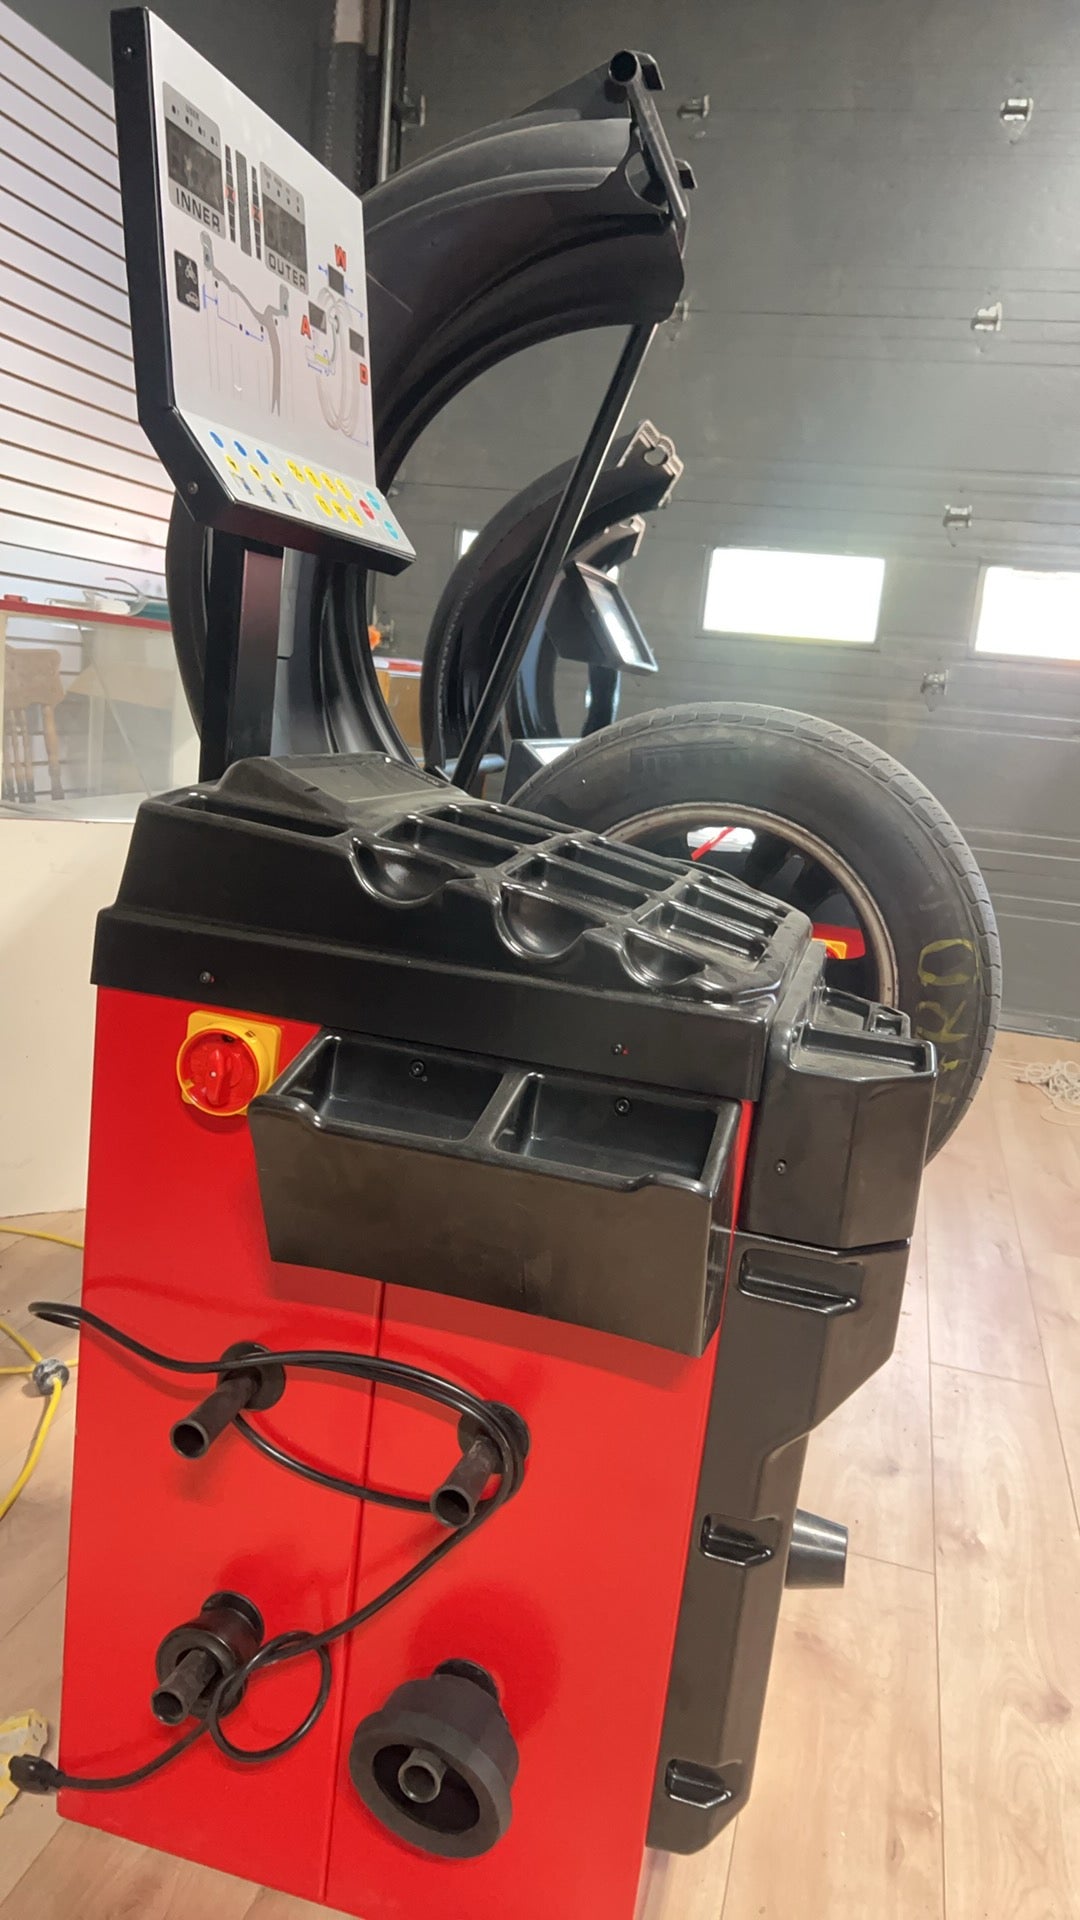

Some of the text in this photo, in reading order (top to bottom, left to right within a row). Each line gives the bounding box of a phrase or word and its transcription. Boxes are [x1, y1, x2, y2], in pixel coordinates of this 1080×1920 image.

[175, 187, 221, 233] INNER
[268, 257, 307, 290] OUTER
[300, 314, 312, 340] A
